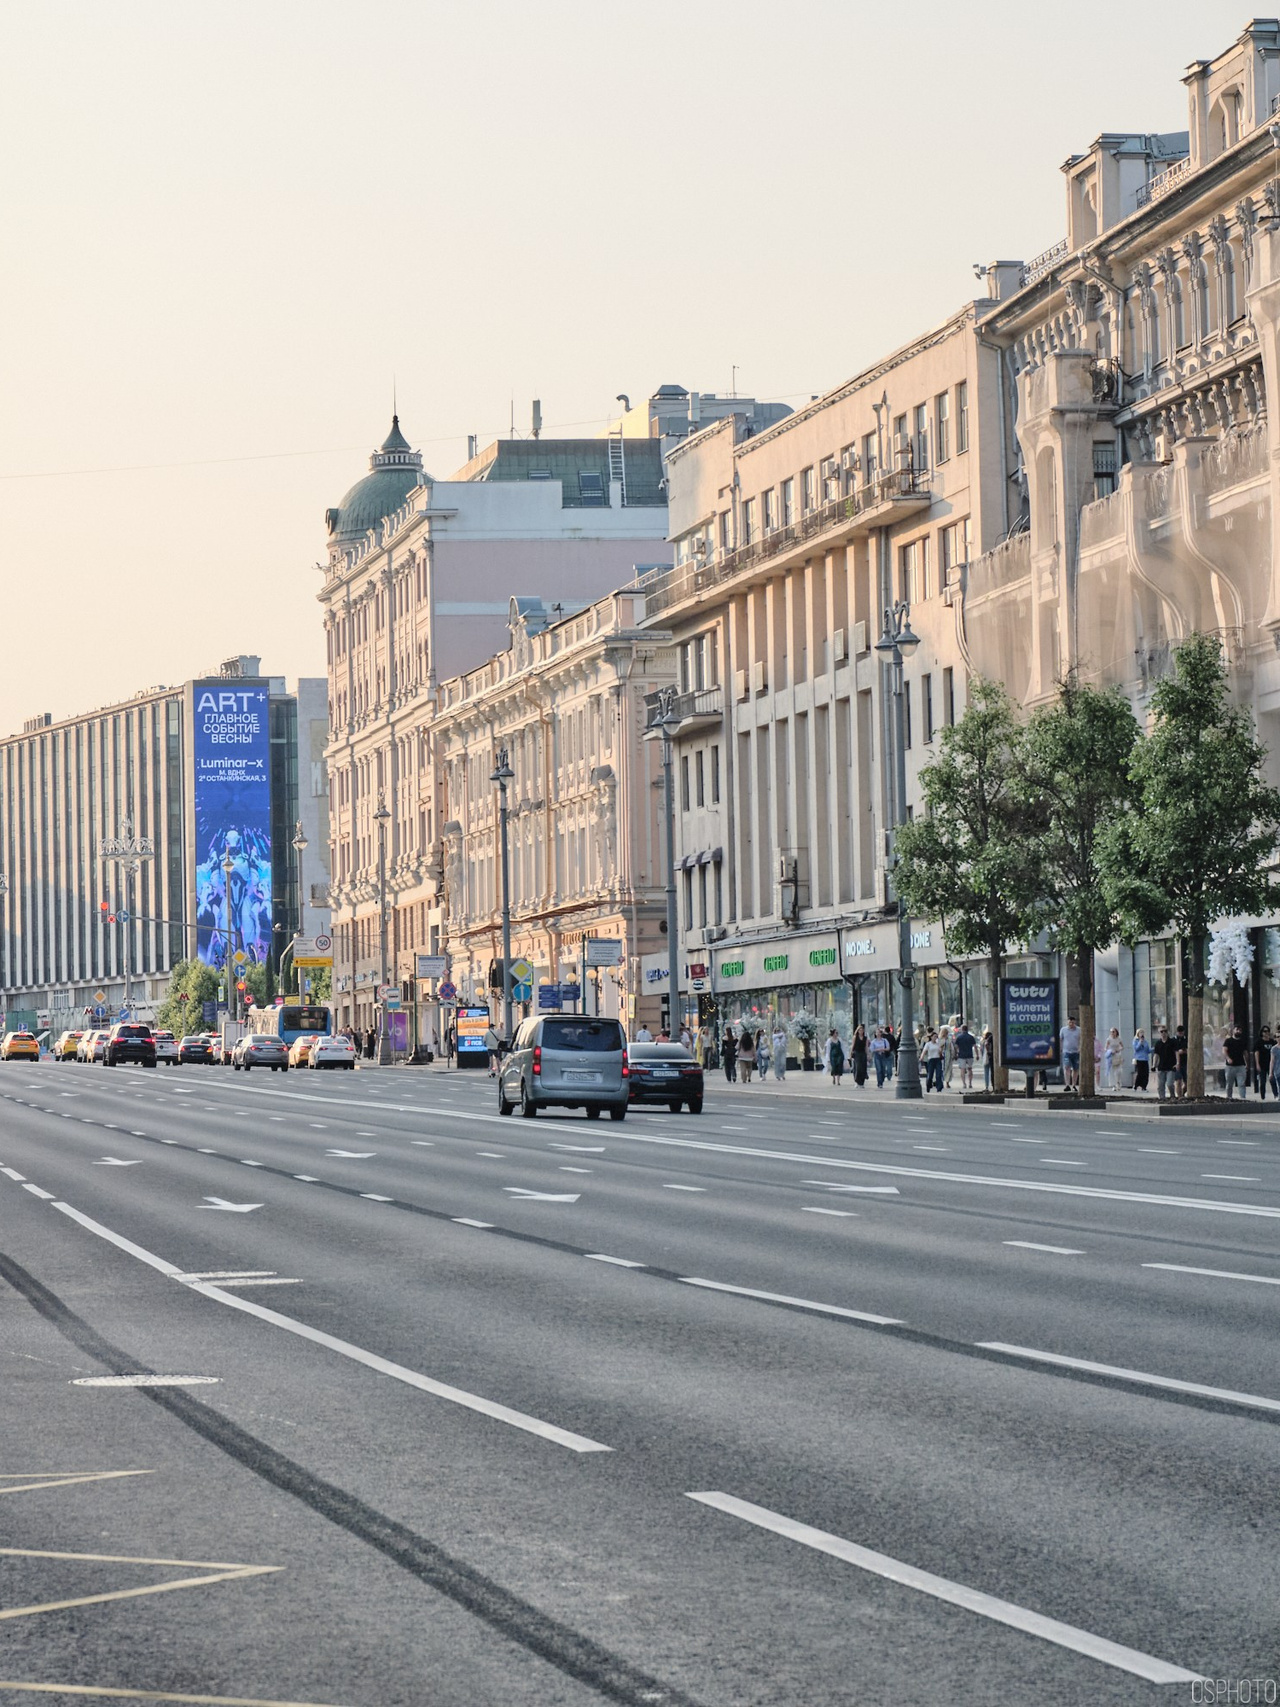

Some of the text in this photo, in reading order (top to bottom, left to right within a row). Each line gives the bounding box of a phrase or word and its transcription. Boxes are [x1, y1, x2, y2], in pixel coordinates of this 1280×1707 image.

[204, 713, 259, 723] ГЛАВНОЕ
[203, 723, 260, 733] СОБЫТИЕ
[211, 733, 252, 744] ВЕСНЫ
[318, 939, 328, 947] 50
[1009, 985, 1049, 998] tutu
[1009, 1003, 1050, 1012] Билеты
[1009, 1014, 1051, 1022] и отели
[1023, 1025, 1042, 1034] 990
